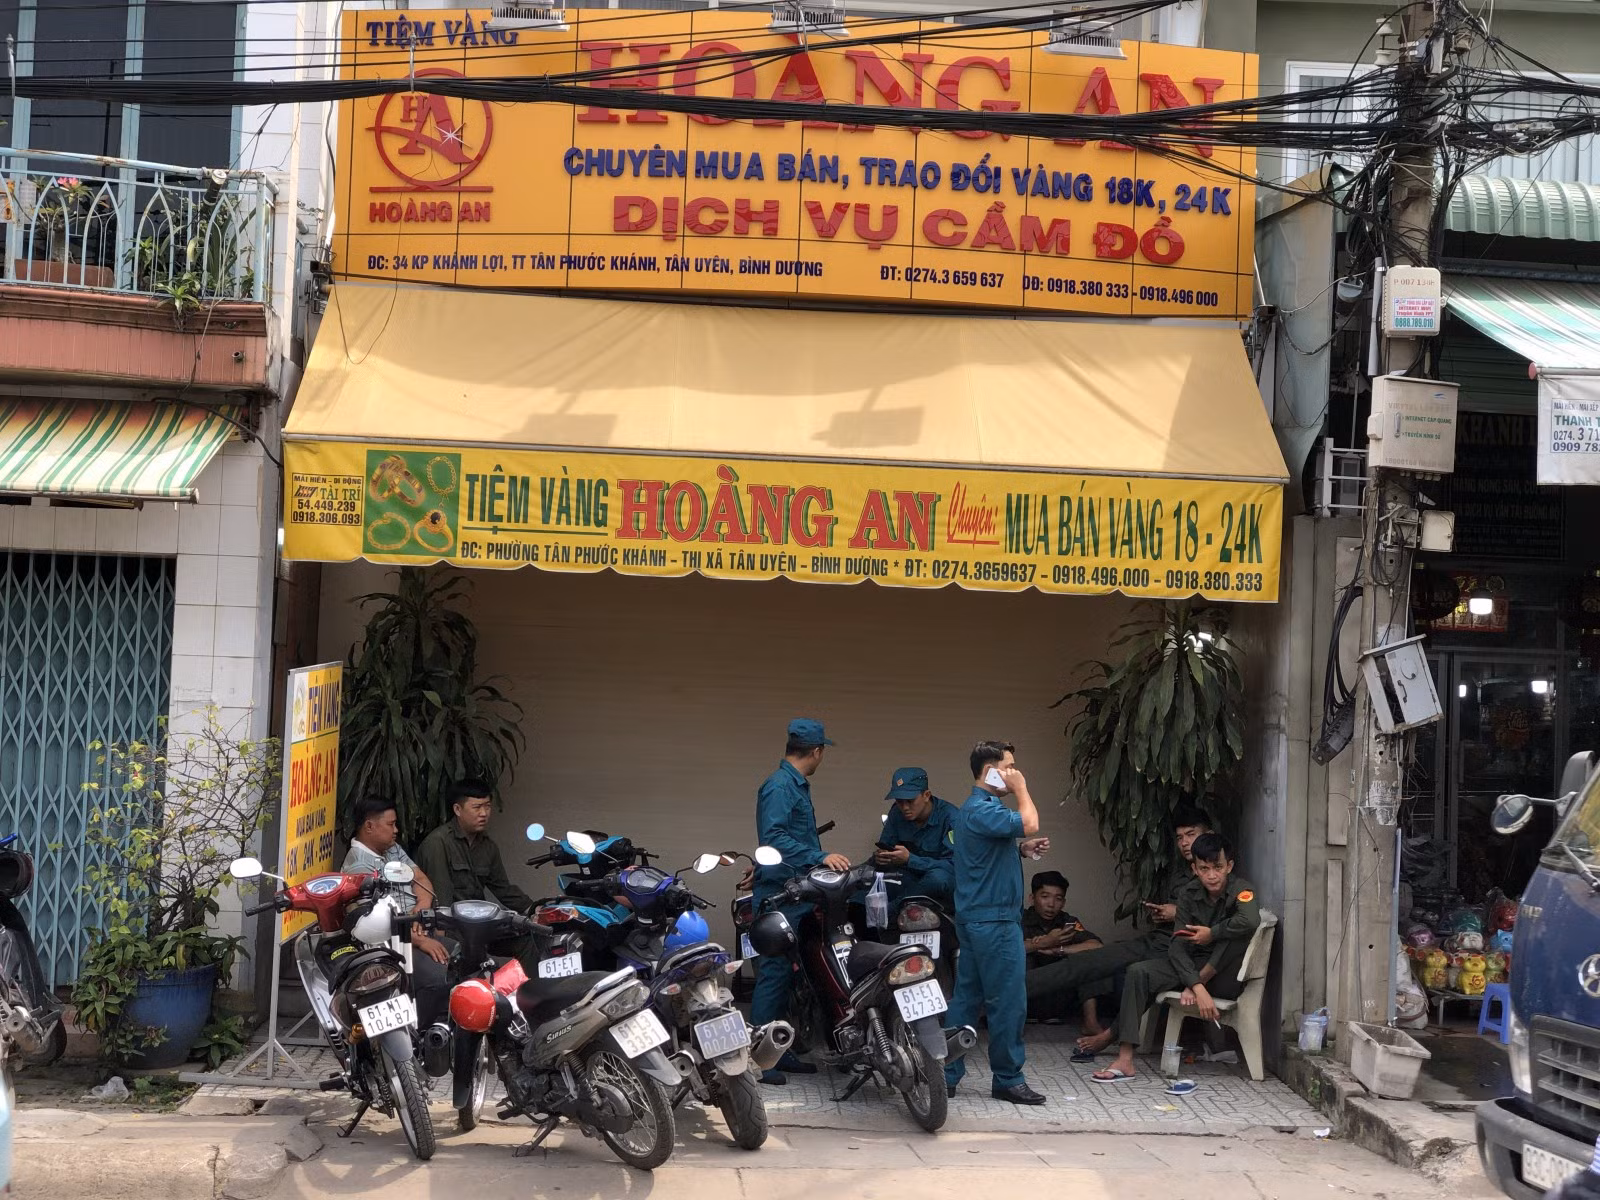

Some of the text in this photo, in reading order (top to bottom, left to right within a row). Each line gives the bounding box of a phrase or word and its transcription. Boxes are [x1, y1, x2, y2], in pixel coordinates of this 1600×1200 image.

[366, 12, 518, 49] TIỆM VÀNG
[577, 33, 1224, 158] HOÀNG AN
[563, 143, 1232, 216] CHUYÊN MUA BÁN, TRAO ĐỔI VÀNG 18K, 24K
[369, 197, 491, 223] HOÀNG AN
[613, 195, 1185, 265] DỊCH VỤ CẦM ĐỒ
[367, 252, 823, 277] ĐC: 34 KP KHÁNH LỢI, TT TÂN PHƯỚC KHÁNH, TÂN UYÊN, BÌNH DƯƠNG
[880, 265, 1004, 288] ĐT: 0274.3 659 637
[1022, 275, 1044, 292] DĐ:
[1047, 276, 1103, 297] 0918.380
[1105, 282, 1129, 299] 333
[1139, 285, 1194, 305] 0918.496
[1196, 290, 1219, 307] 000
[1554, 414, 1592, 427] THANH
[1553, 441, 1600, 452] 0909 78
[1577, 427, 1585, 441] 3
[320, 484, 362, 501] TÀI TRÍ
[292, 511, 361, 525] 0918.306.093
[297, 499, 356, 512] 54.449.239
[465, 464, 529, 535] TIỆM
[540, 465, 609, 529] VÀNG
[615, 463, 838, 548] HOÀNG
[848, 489, 941, 552] AN
[1005, 492, 1051, 556] MUA
[1057, 480, 1100, 558] BÁN
[1109, 481, 1164, 561] VÀNG
[1173, 500, 1199, 563] 18
[1220, 501, 1264, 564] 24K
[461, 541, 482, 559] ĐC:
[486, 539, 539, 562] PHƯỜNG
[544, 542, 571, 563] TÂN
[574, 543, 618, 566] PHƯỚC
[622, 546, 667, 567] KHÁNH
[706, 547, 723, 569] XÃ
[729, 549, 756, 570] TÂN
[759, 551, 797, 573] UYÊN
[811, 553, 841, 575] BÌNH
[845, 555, 888, 577] DƯƠNG
[904, 558, 928, 578] ĐT:
[932, 560, 1037, 583] 0274.3659637
[1052, 565, 1150, 588] 0918.496.000
[1165, 569, 1263, 592] 0918.380.333
[290, 743, 336, 808] HOÀNG AN
[544, 956, 575, 975] 61-E1
[901, 983, 935, 1005] 61-E1
[902, 996, 944, 1019] 347.33
[367, 1009, 411, 1034] 104.87
